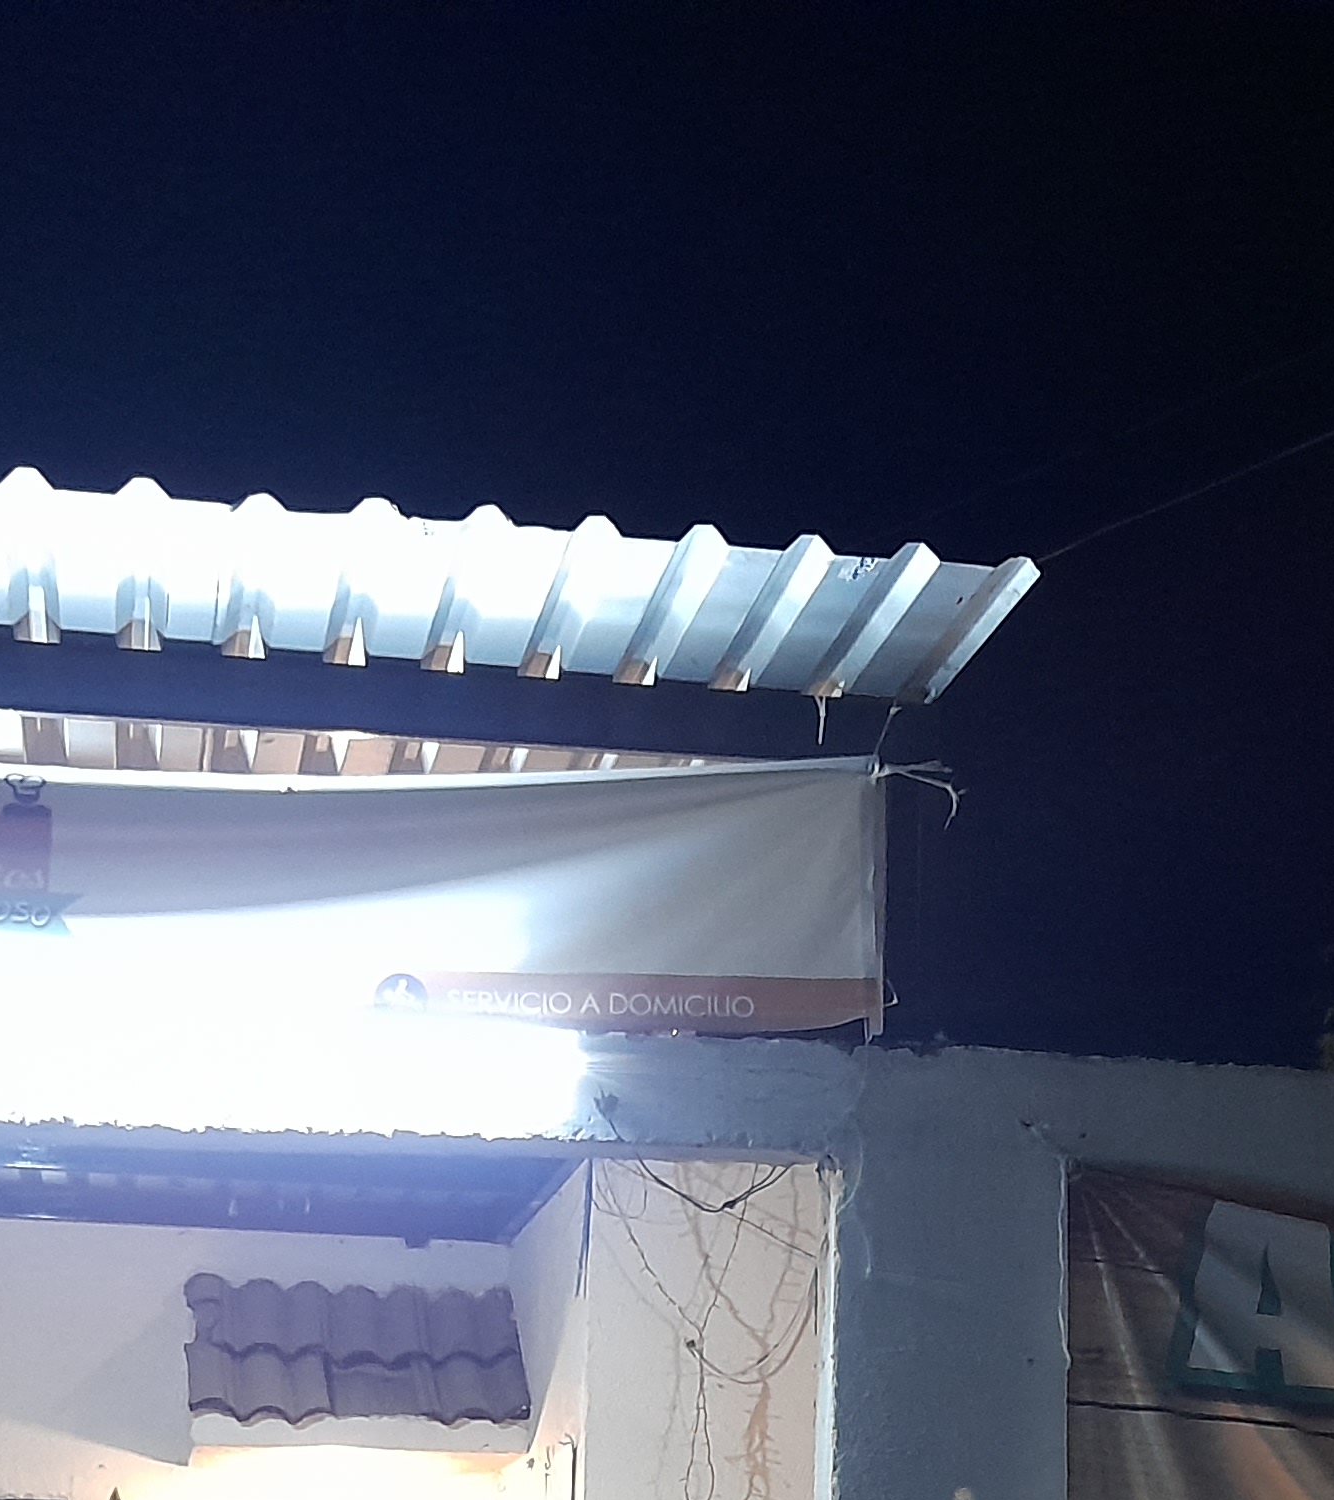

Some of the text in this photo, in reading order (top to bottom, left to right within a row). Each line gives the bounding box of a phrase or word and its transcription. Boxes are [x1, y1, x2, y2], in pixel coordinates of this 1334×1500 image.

[447, 990, 755, 1018] SERVICIO A DOMICILIO
